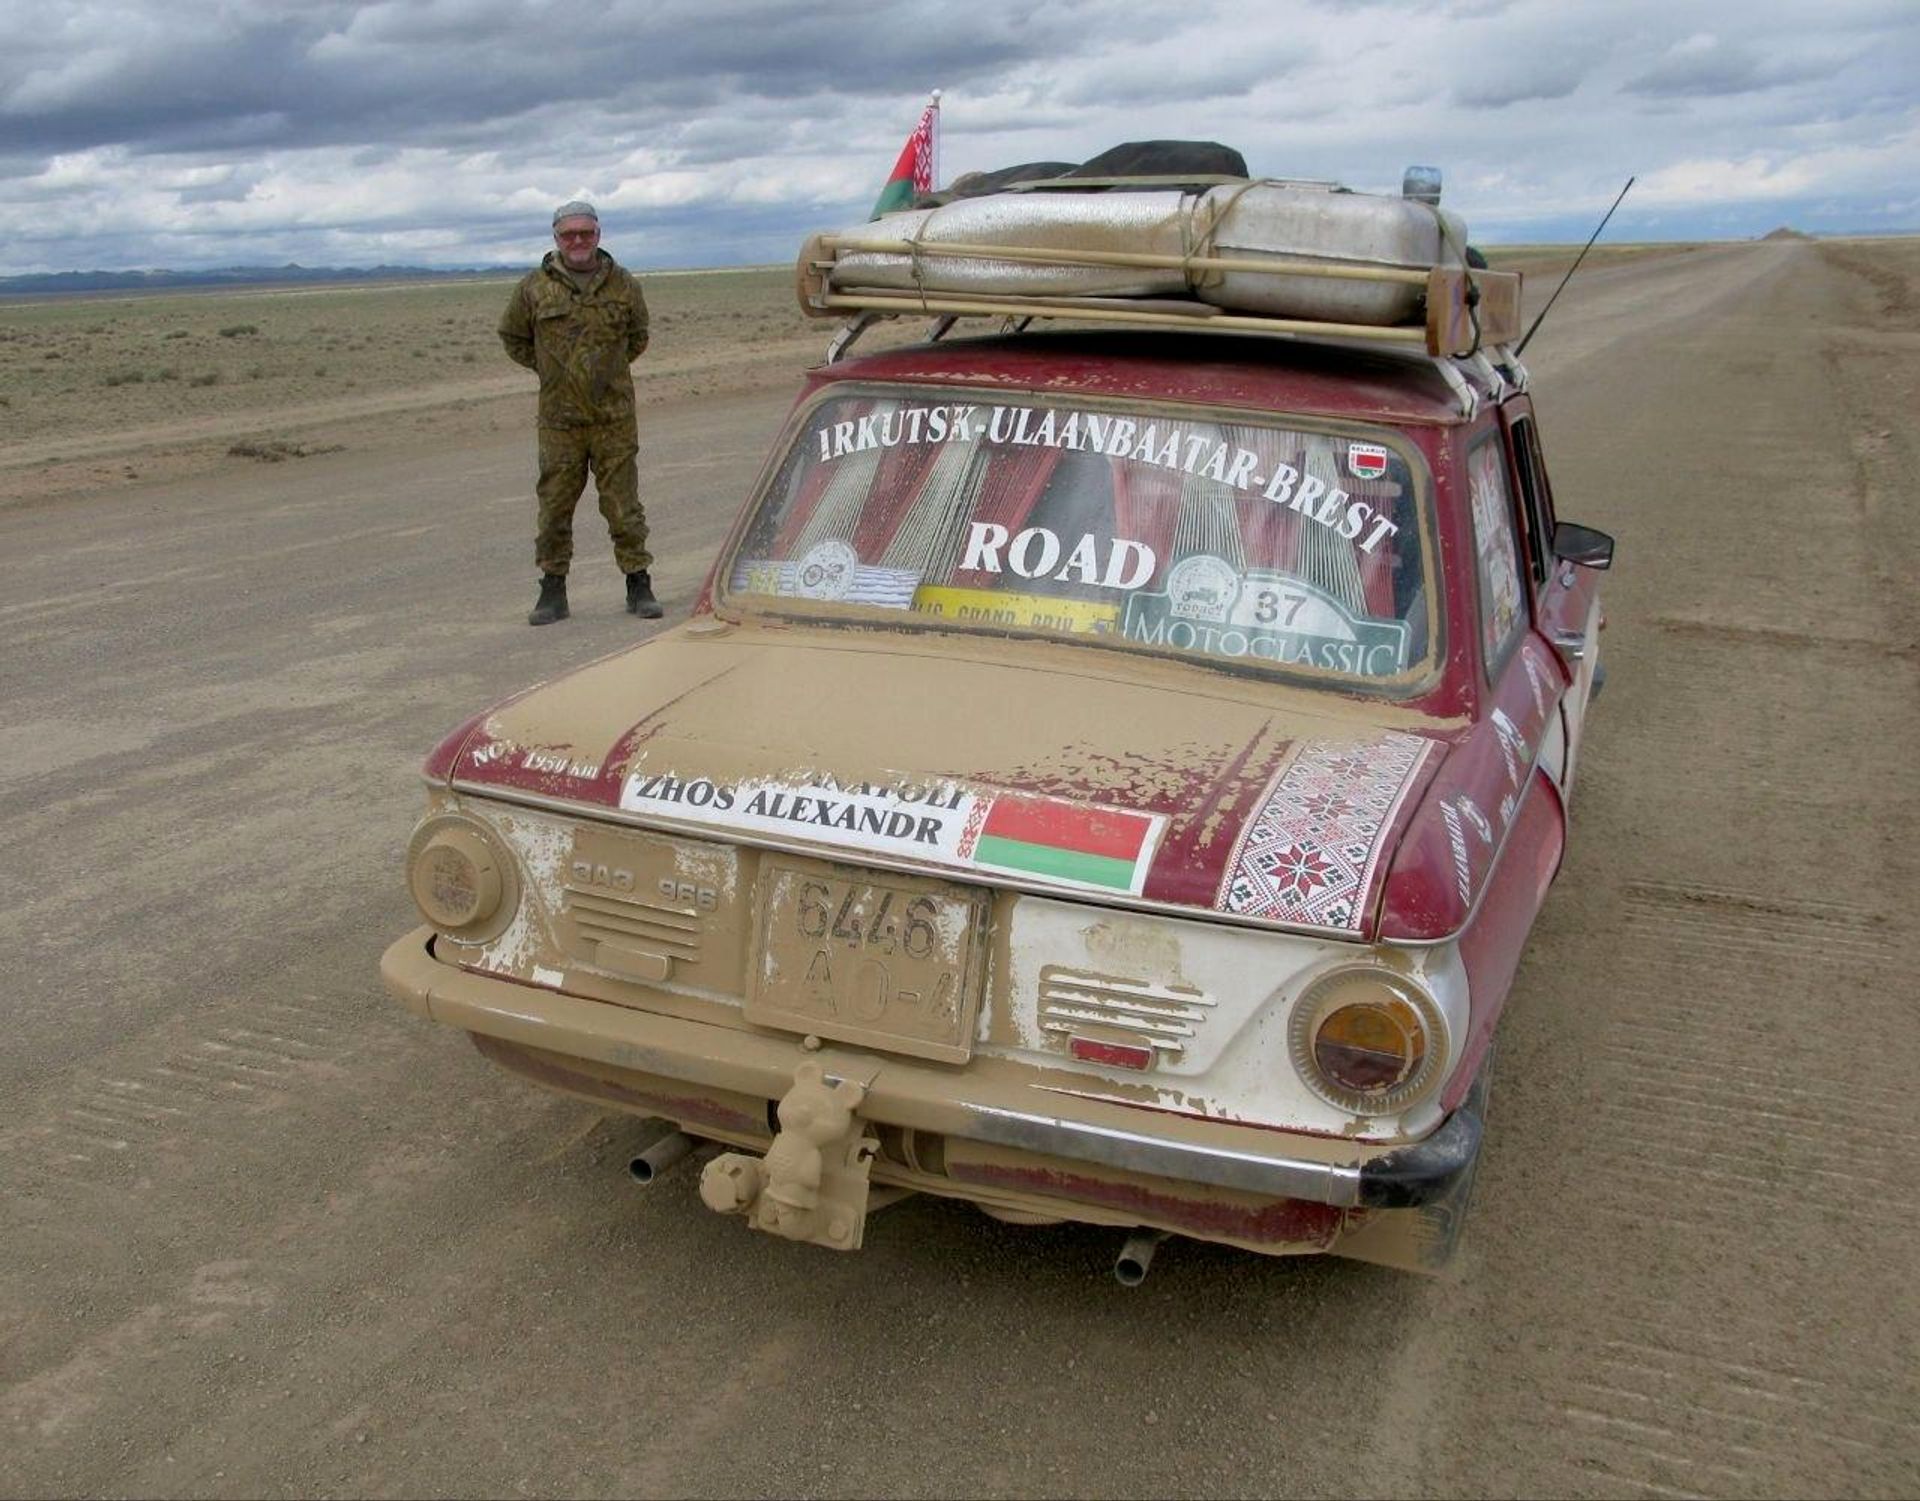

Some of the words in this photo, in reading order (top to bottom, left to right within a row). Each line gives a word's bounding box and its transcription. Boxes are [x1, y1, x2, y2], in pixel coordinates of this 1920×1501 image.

[818, 405, 1398, 554] IRKUTSK-ULAANBAATAR-BREST
[959, 521, 1156, 590] ROAD
[1254, 590, 1308, 626] 37
[1134, 611, 1394, 676] MOTOCLASSIC
[636, 774, 738, 811] ZHOS
[743, 789, 944, 845] ALEXANDR
[798, 881, 938, 960] 6446
